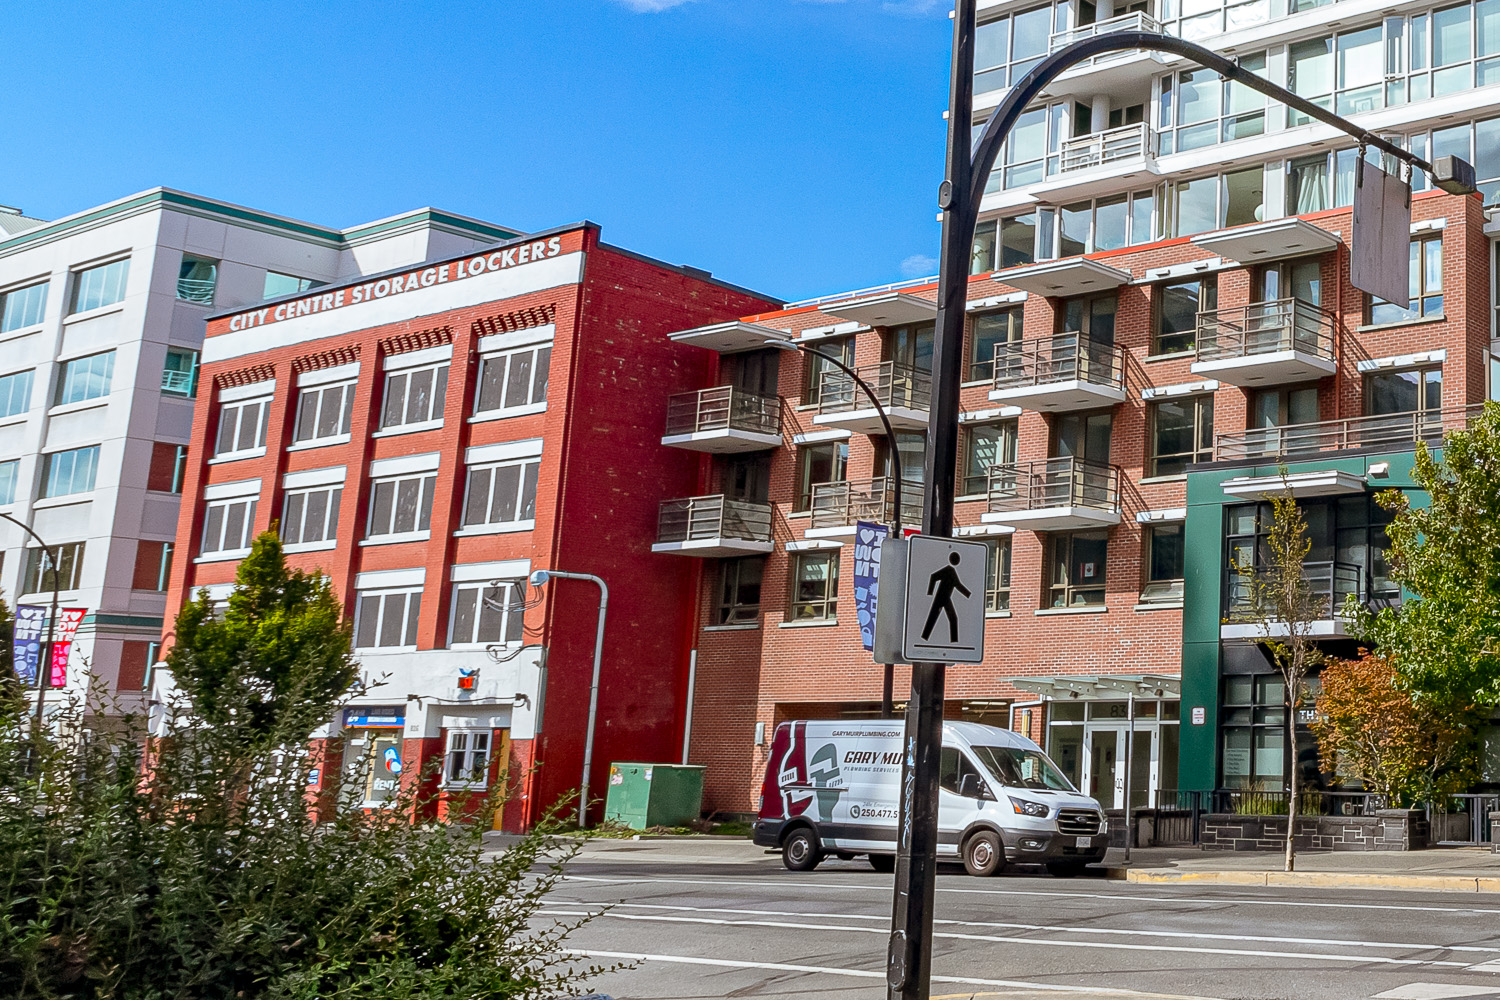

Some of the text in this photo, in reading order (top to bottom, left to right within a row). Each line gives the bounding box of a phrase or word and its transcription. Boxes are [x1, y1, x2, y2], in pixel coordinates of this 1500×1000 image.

[230, 236, 561, 332] CITY CENTRE STORAGE LOCKERS
[844, 751, 904, 765] GARY MU
[861, 808, 900, 818] 250.477.5
